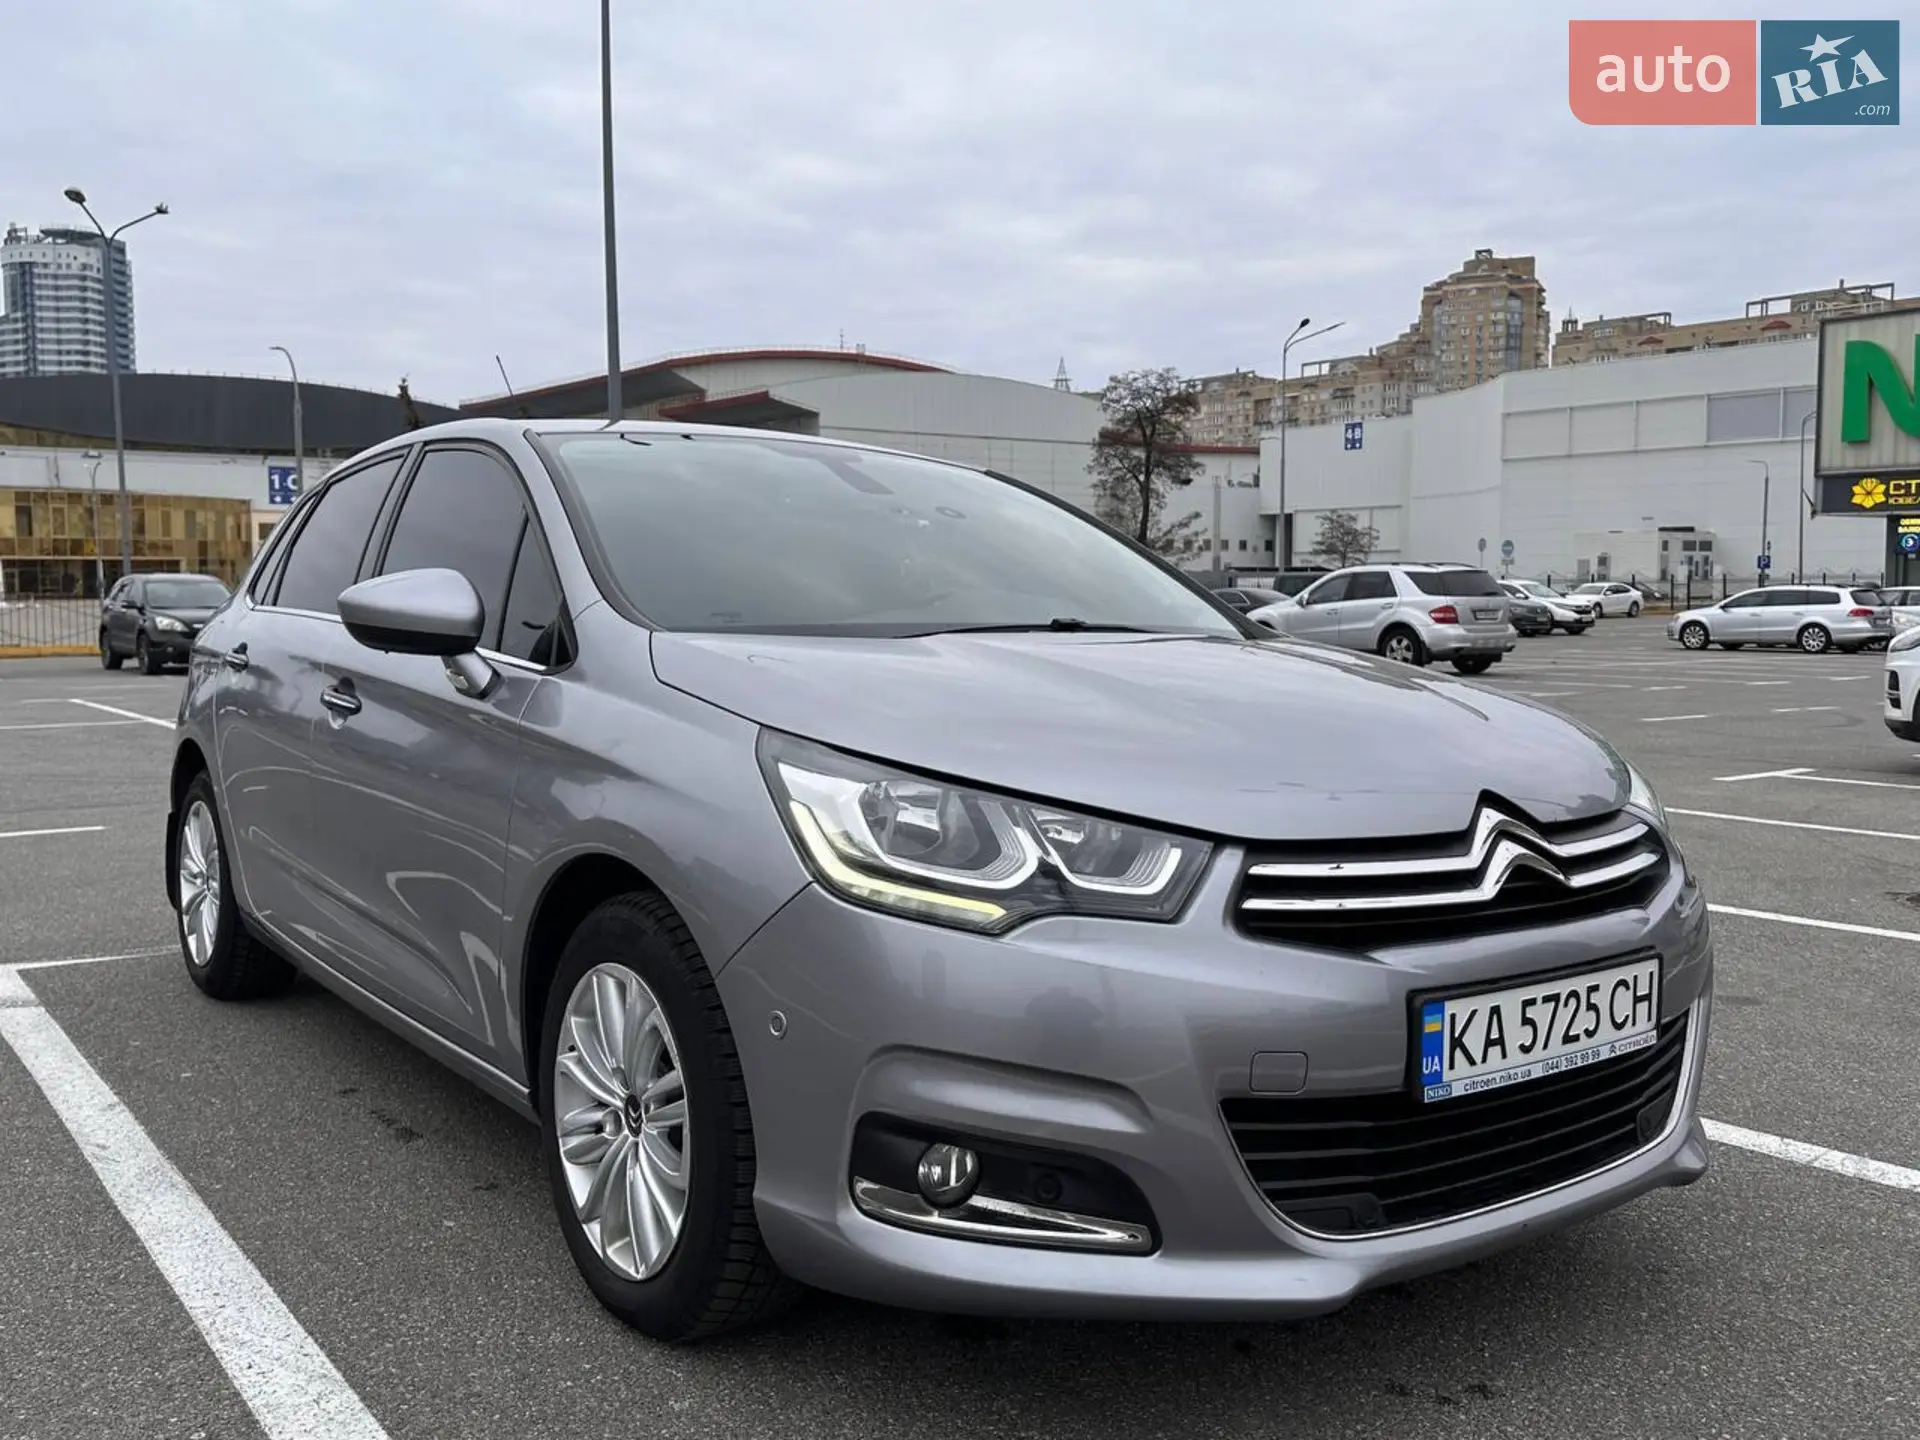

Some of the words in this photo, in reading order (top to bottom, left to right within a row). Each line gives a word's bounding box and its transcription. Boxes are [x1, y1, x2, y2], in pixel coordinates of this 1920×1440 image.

[1448, 1003, 1508, 1071] KA
[1518, 983, 1601, 1054] 5725
[1609, 969, 1655, 1032] CH
[1422, 1056, 1441, 1074] UA
[1565, 1055, 1579, 1068] 392
[1427, 1085, 1451, 1099] NIKO
